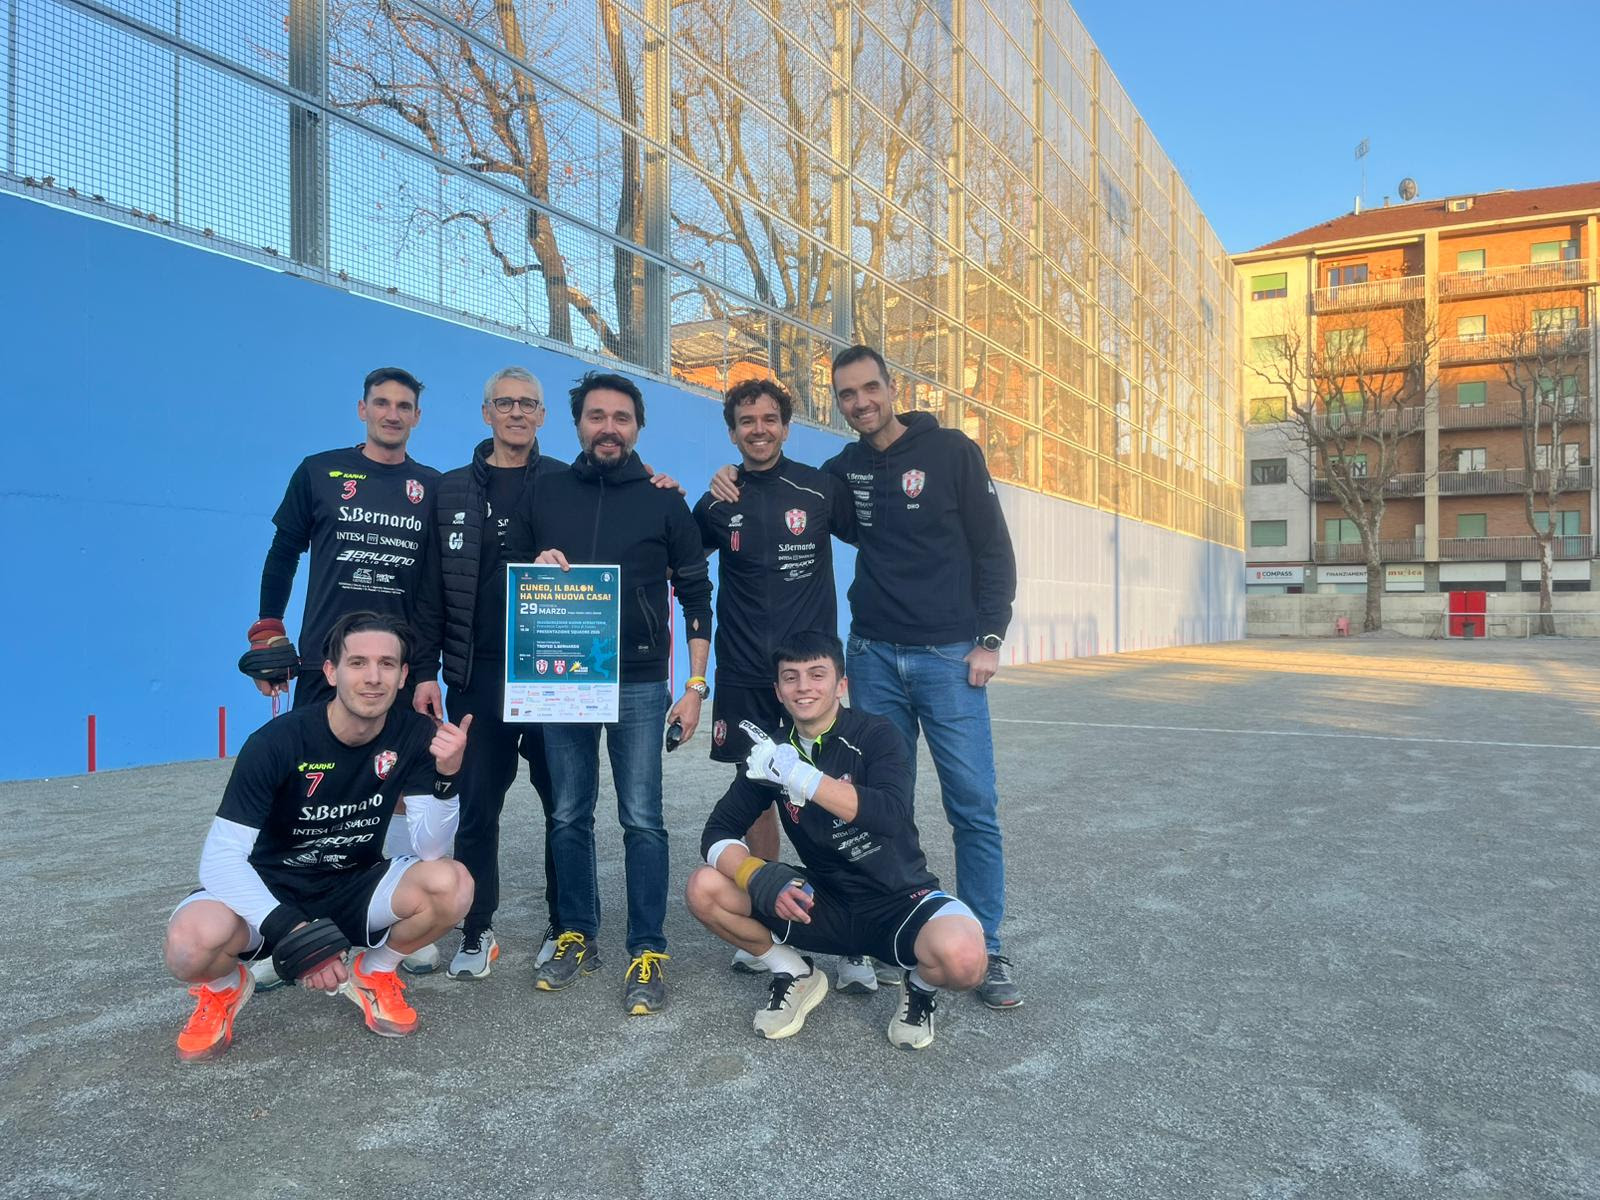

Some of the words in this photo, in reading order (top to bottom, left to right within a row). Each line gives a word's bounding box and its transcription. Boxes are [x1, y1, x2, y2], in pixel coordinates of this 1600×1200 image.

[341, 480, 357, 500] 3
[338, 506, 422, 532] S.Bernardo
[336, 531, 365, 543] INTESA
[778, 542, 816, 552] S.Bernardo
[352, 550, 415, 566] BAUDINO
[520, 583, 552, 593] CUNEO,
[554, 584, 562, 592] IL
[563, 584, 594, 592] BALON
[586, 593, 612, 601] CASA!
[520, 602, 538, 615] 29
[308, 762, 336, 770] KARHU
[305, 772, 324, 797] 7
